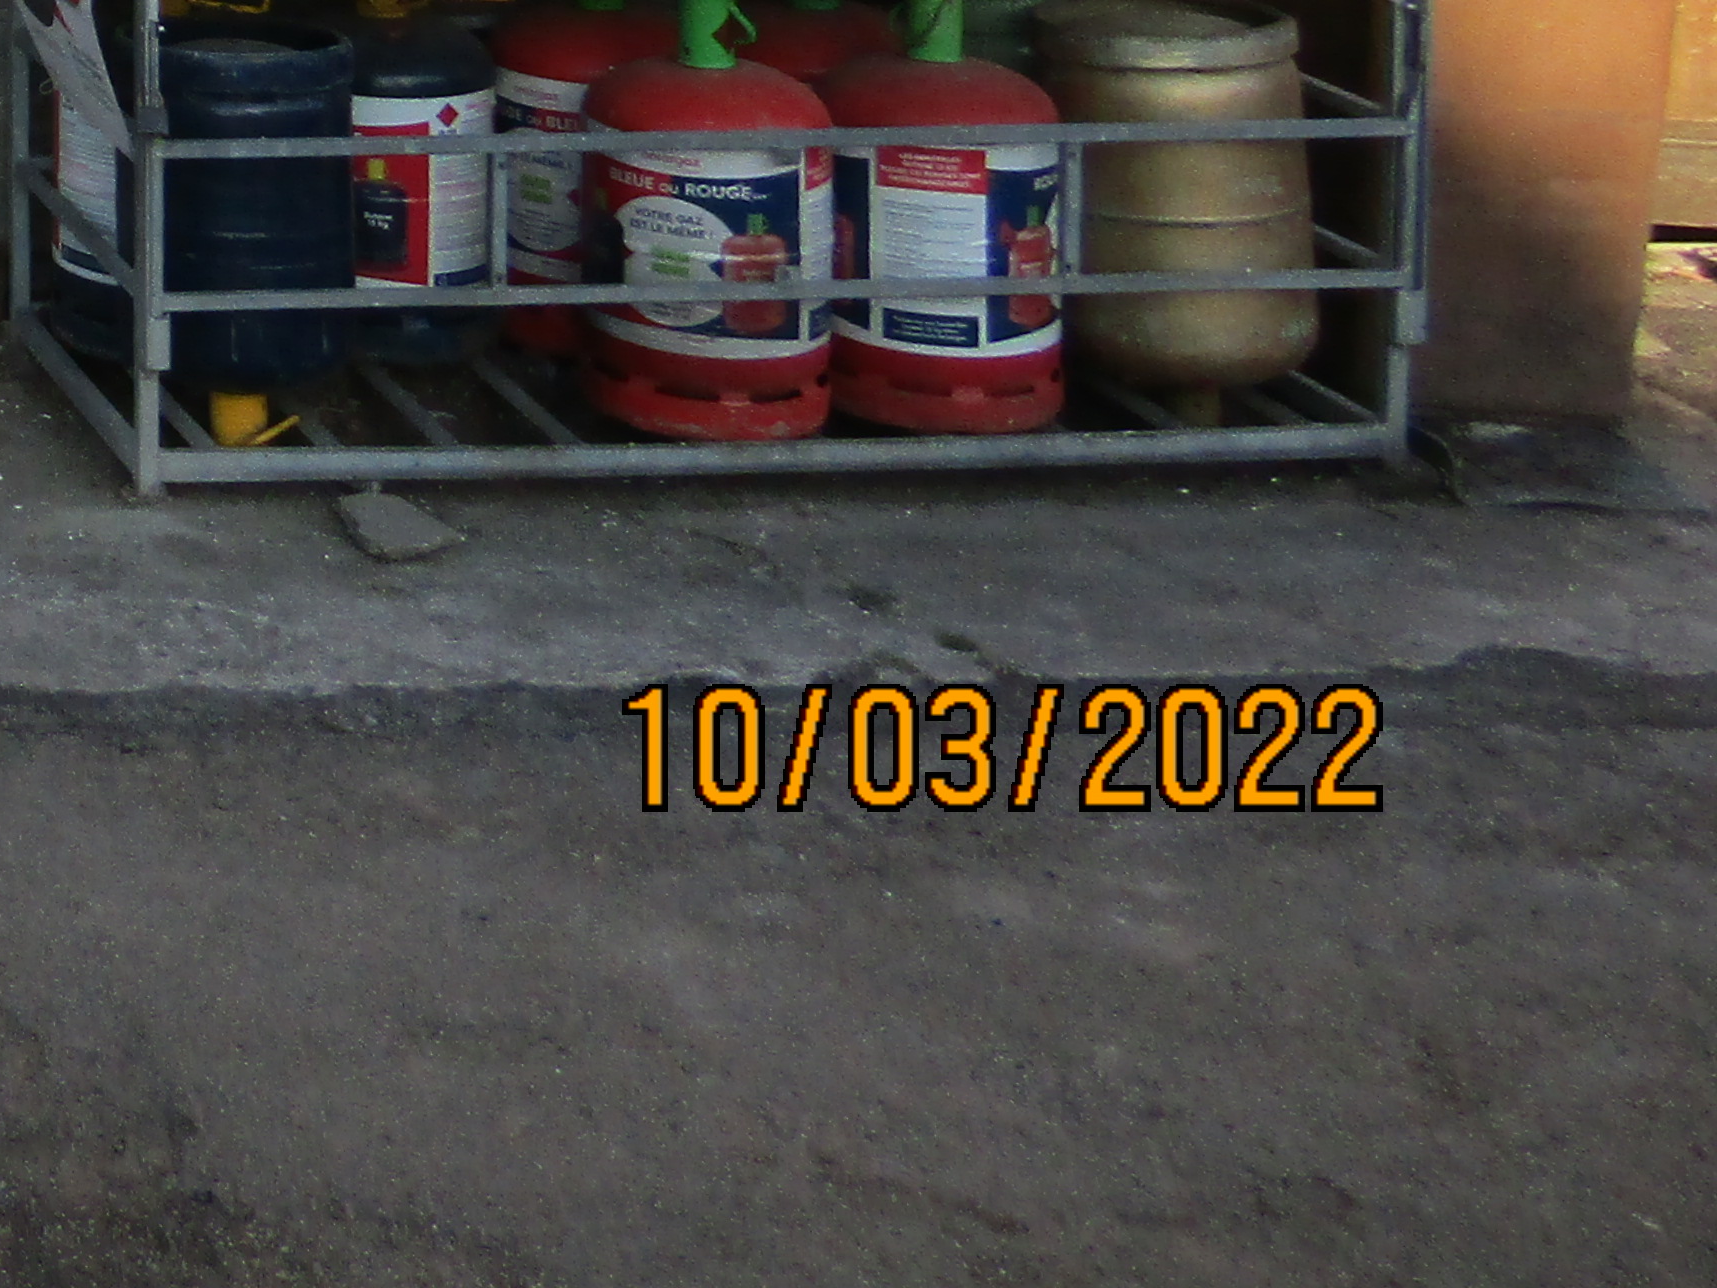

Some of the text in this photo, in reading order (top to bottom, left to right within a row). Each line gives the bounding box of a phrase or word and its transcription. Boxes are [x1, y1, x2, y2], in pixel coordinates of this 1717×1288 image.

[609, 166, 655, 191] BLEUE
[635, 207, 703, 226] VOTRE GAZ
